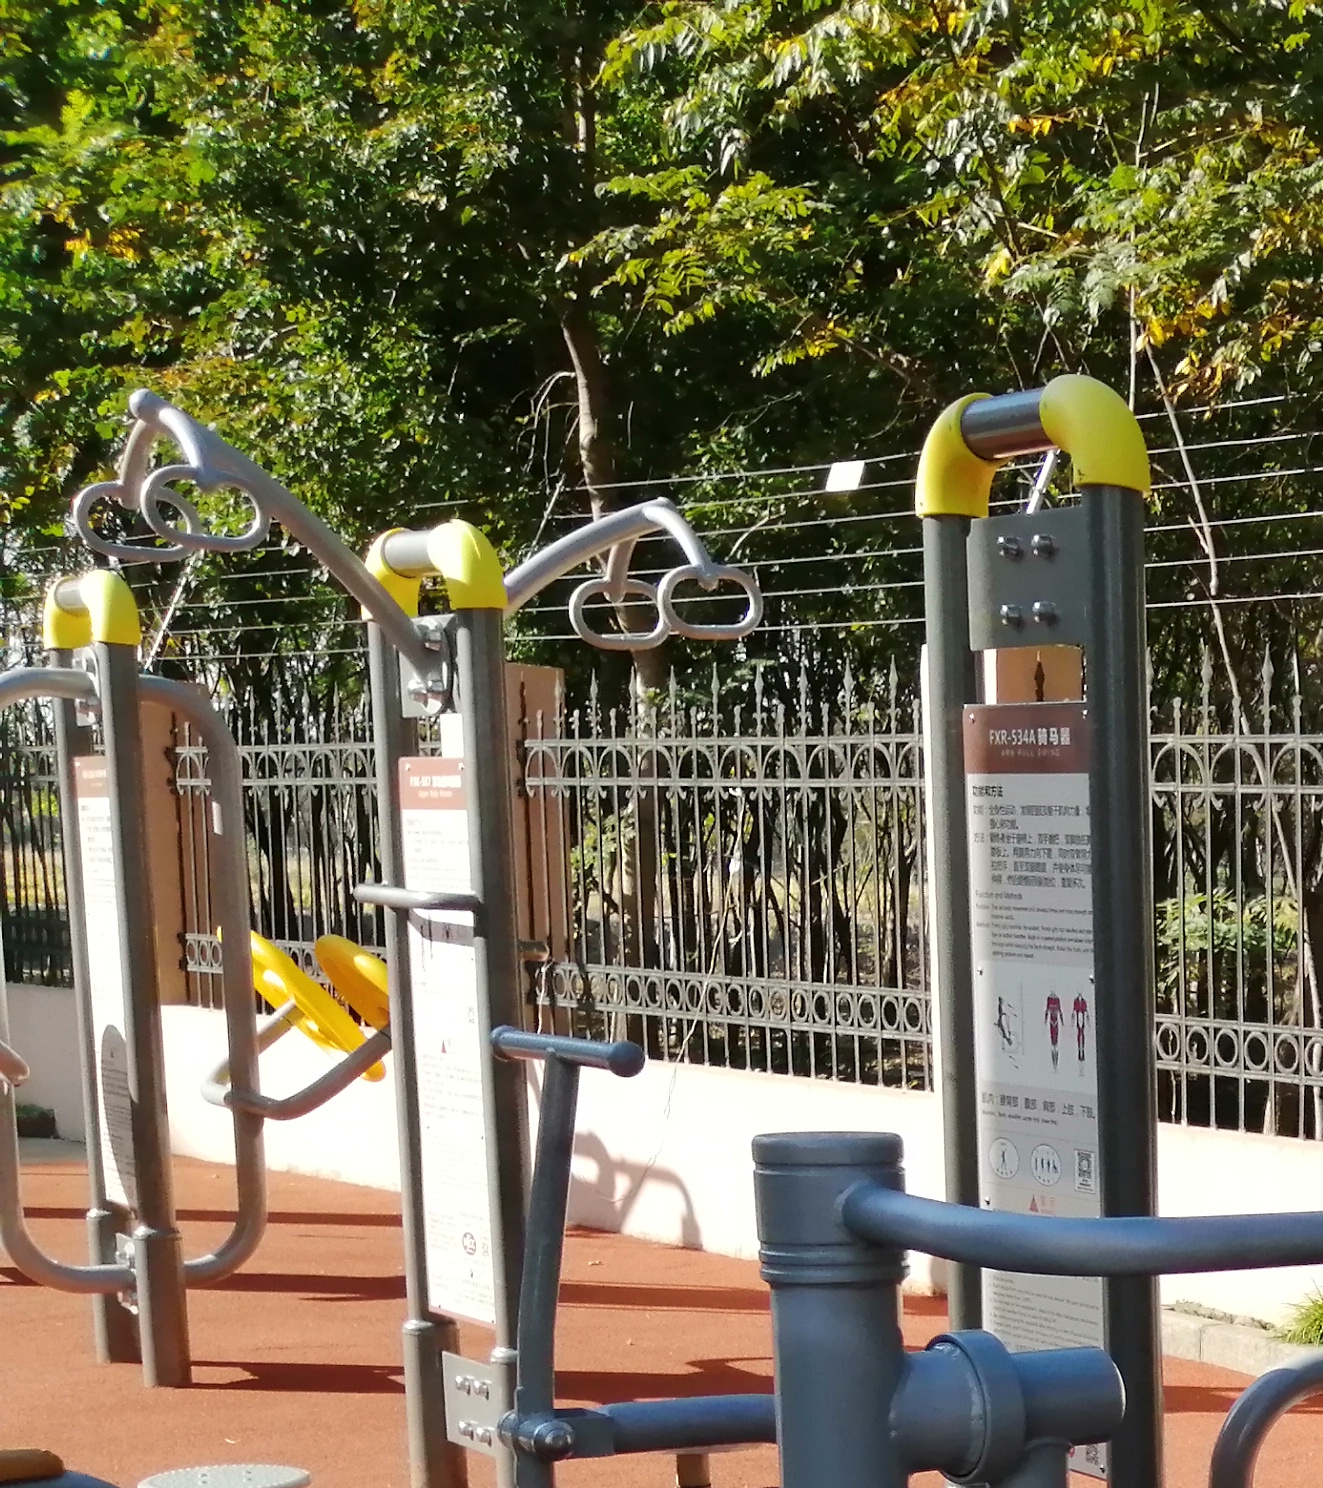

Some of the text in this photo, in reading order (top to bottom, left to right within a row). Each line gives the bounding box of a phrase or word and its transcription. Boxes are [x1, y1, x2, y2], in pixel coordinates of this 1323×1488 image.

[990, 727, 1071, 746] FXR-534A 骑马器
